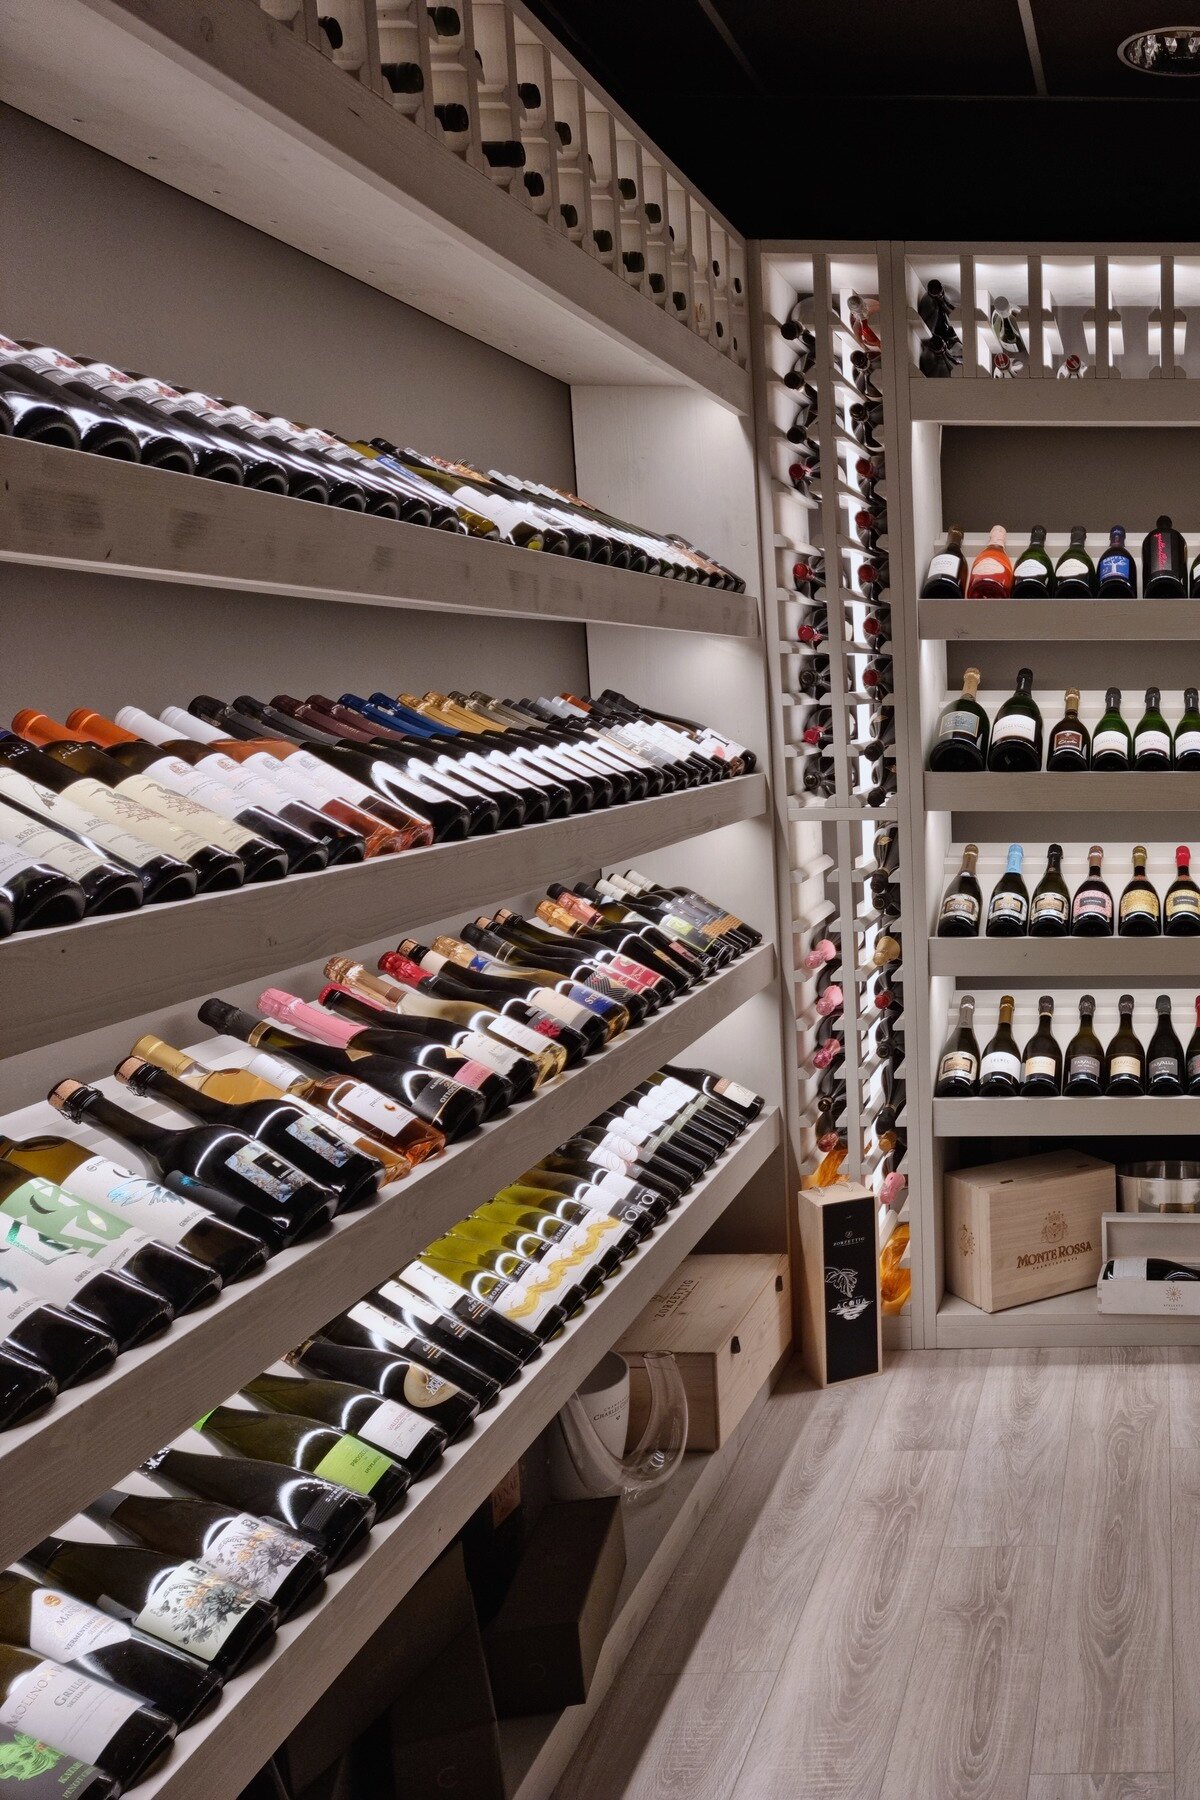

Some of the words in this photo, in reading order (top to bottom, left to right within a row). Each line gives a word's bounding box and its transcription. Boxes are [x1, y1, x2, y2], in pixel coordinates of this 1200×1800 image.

[655, 1278, 694, 1318] ZORZETTIG
[836, 1298, 866, 1309] ACQUA
[6, 1678, 49, 1729] MOLINO
